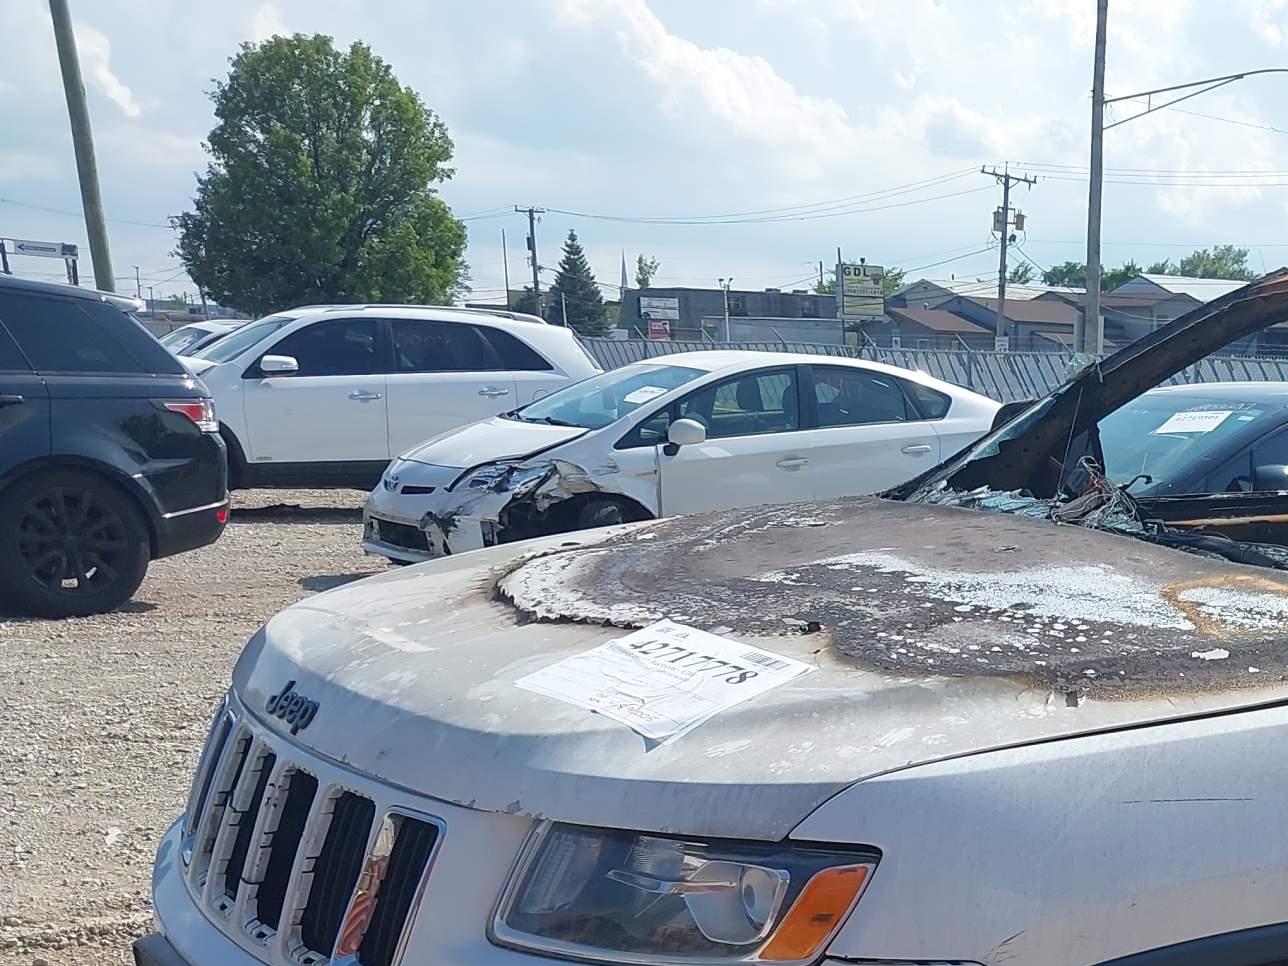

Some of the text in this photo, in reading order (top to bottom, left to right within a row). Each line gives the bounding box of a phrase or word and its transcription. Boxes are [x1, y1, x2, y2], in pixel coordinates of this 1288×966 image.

[843, 266, 870, 277] GDL
[628, 639, 759, 685] 42717778
[266, 679, 321, 736] Jeep
